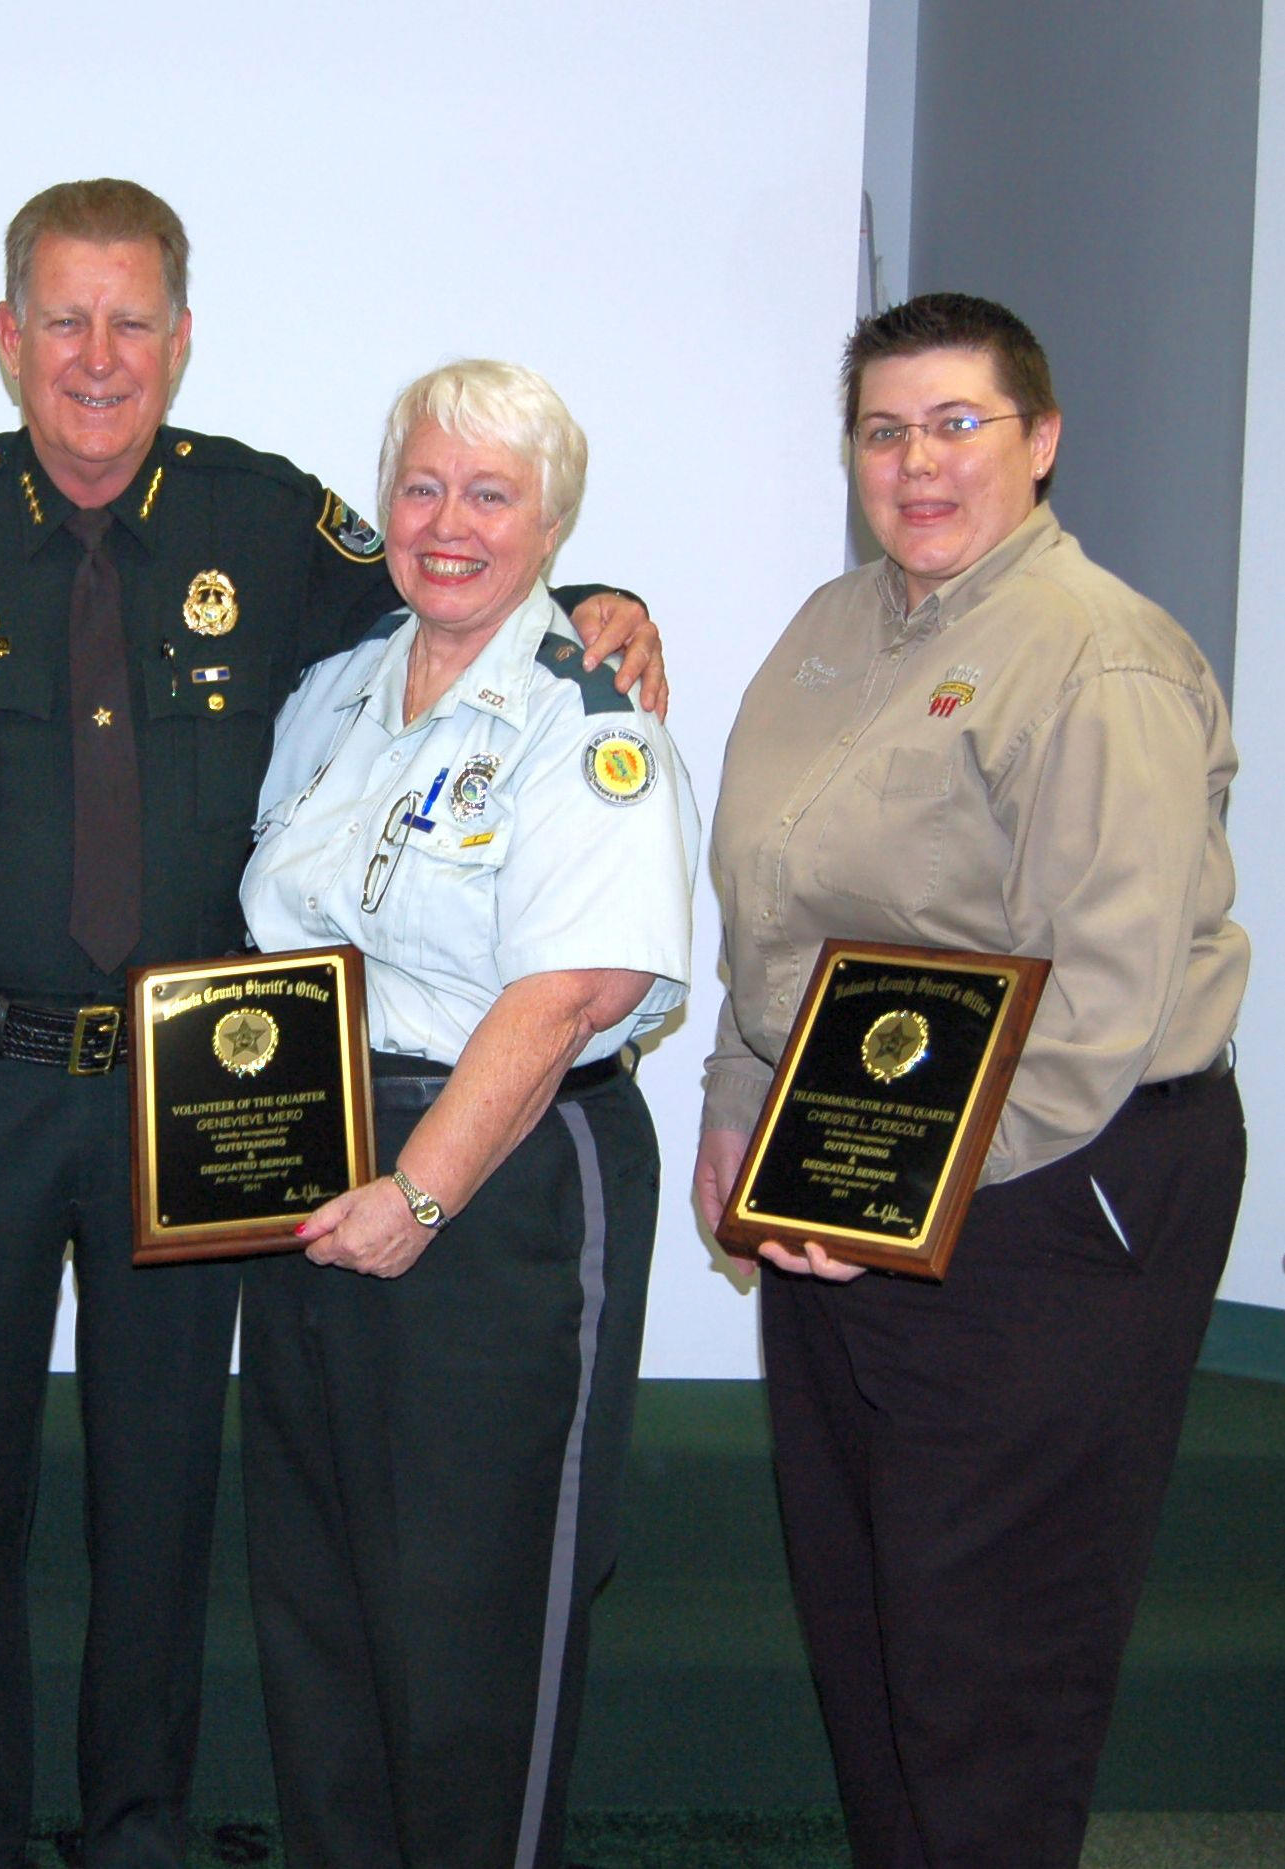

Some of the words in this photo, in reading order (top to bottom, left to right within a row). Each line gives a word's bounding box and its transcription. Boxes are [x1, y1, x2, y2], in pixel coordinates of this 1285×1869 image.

[204, 983, 243, 1004] County
[245, 979, 293, 998] Sheriff's
[296, 981, 330, 1002] Office
[172, 1100, 236, 1116] VOLUNTEER
[236, 1099, 250, 1110] OF
[254, 1096, 274, 1108] THE
[276, 1090, 326, 1106] QUARTER
[794, 1090, 880, 1112] TELECOMMUNICATOR
[882, 1102, 896, 1113] OF
[896, 1104, 912, 1116] THE
[913, 1106, 956, 1122] QUARTER
[196, 1113, 264, 1131] GENEVIEVE
[268, 1109, 304, 1122] MERO
[808, 1110, 859, 1128] CHRISTIE
[872, 1118, 927, 1138] D'ERCOLE
[216, 1138, 287, 1154] OUTSTANDING
[824, 1140, 890, 1159] OUTSTANDING
[200, 1162, 257, 1176] DEDICATED
[260, 1156, 303, 1170] SERVICE
[802, 1158, 855, 1176] DEDICATED
[856, 1166, 897, 1182] SERVICE
